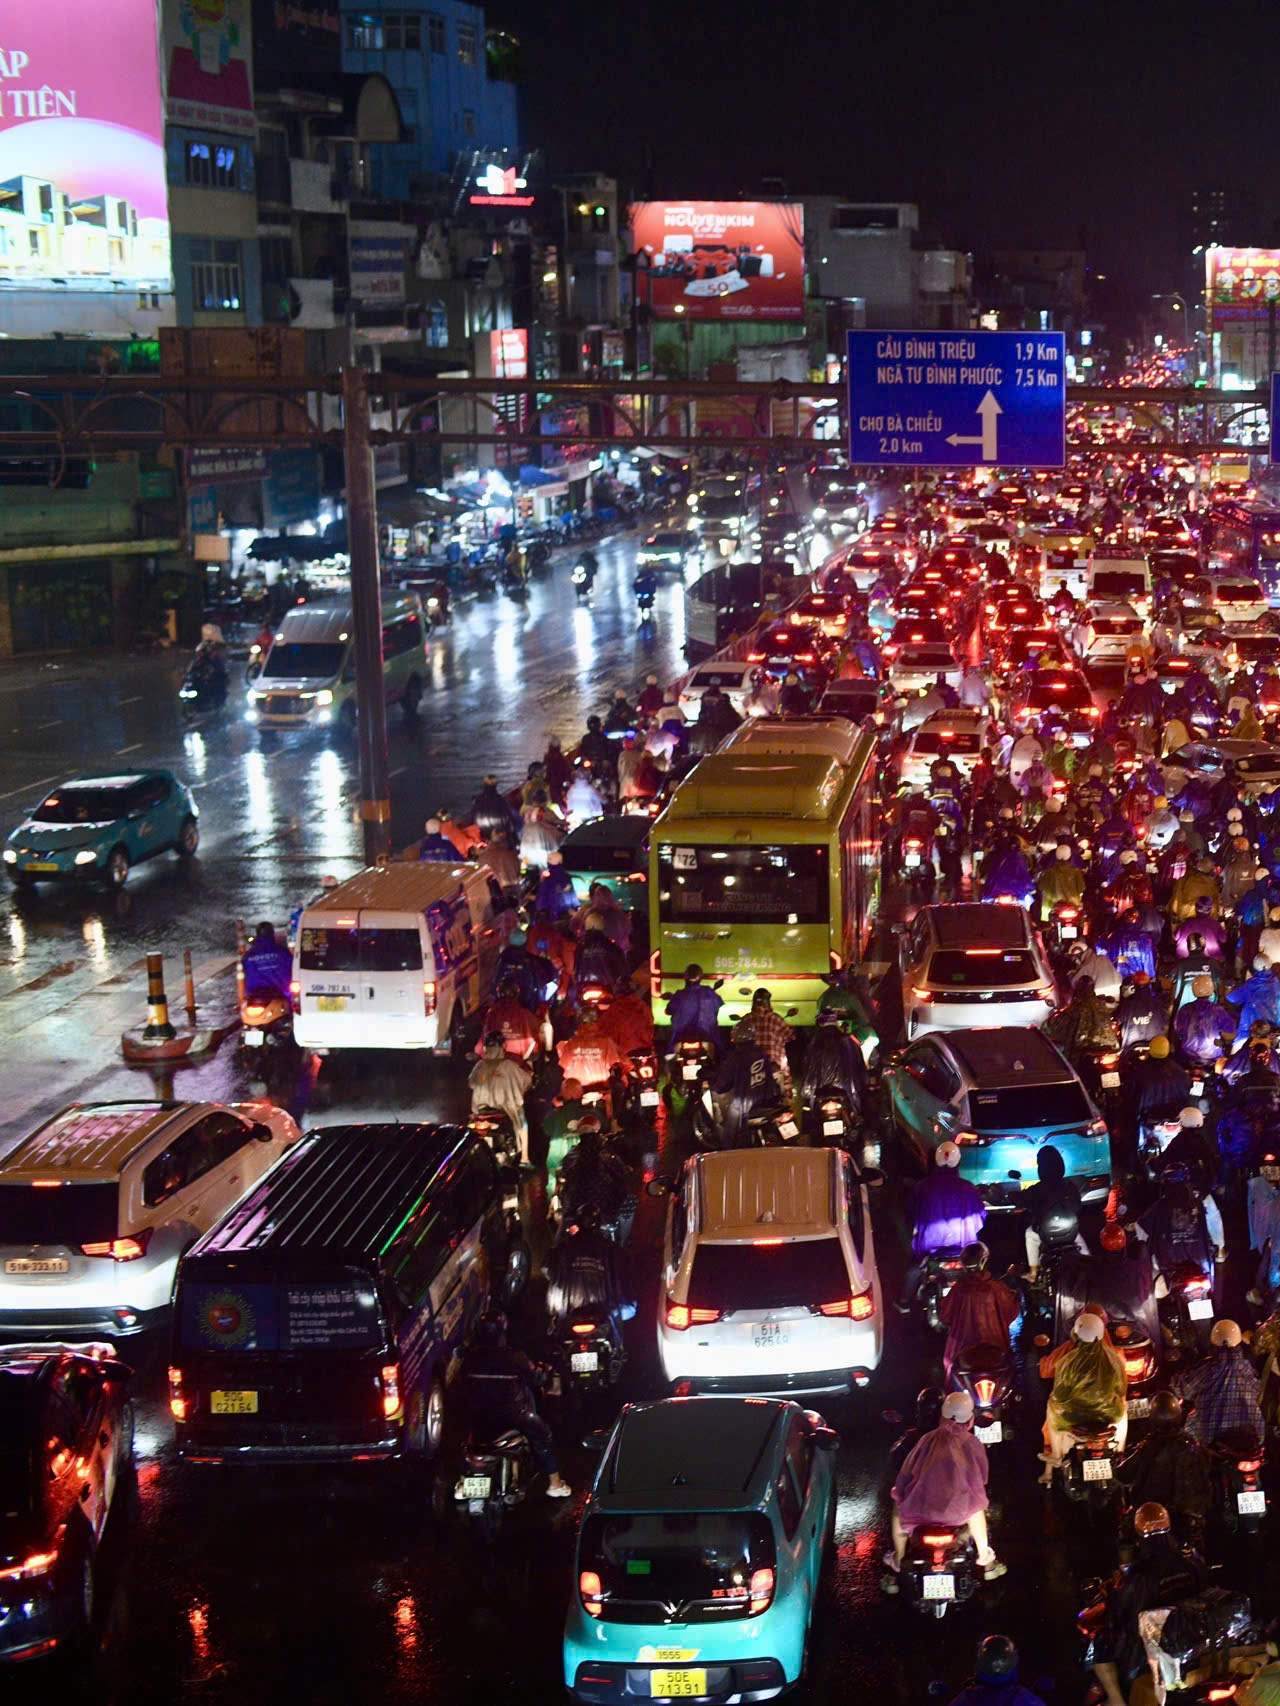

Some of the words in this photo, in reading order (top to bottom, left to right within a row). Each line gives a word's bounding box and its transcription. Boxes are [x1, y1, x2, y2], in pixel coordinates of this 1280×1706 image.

[7, 84, 76, 117] TIÊN
[876, 335, 901, 360] CẦU
[905, 338, 936, 360] BÌNH
[939, 338, 976, 362] TRIỆU
[1037, 343, 1058, 361] Km
[877, 365, 903, 385] NGÃ
[906, 366, 924, 385] TƯ
[926, 363, 957, 385] BÌNH
[960, 363, 1003, 385] PHƯỚC
[1037, 368, 1058, 387] Km
[859, 415, 884, 434] CHỢ
[887, 413, 904, 432] BÀ
[902, 440, 923, 454] km
[667, 1672, 690, 1684] 50E
[659, 1683, 702, 1696] 713.91
